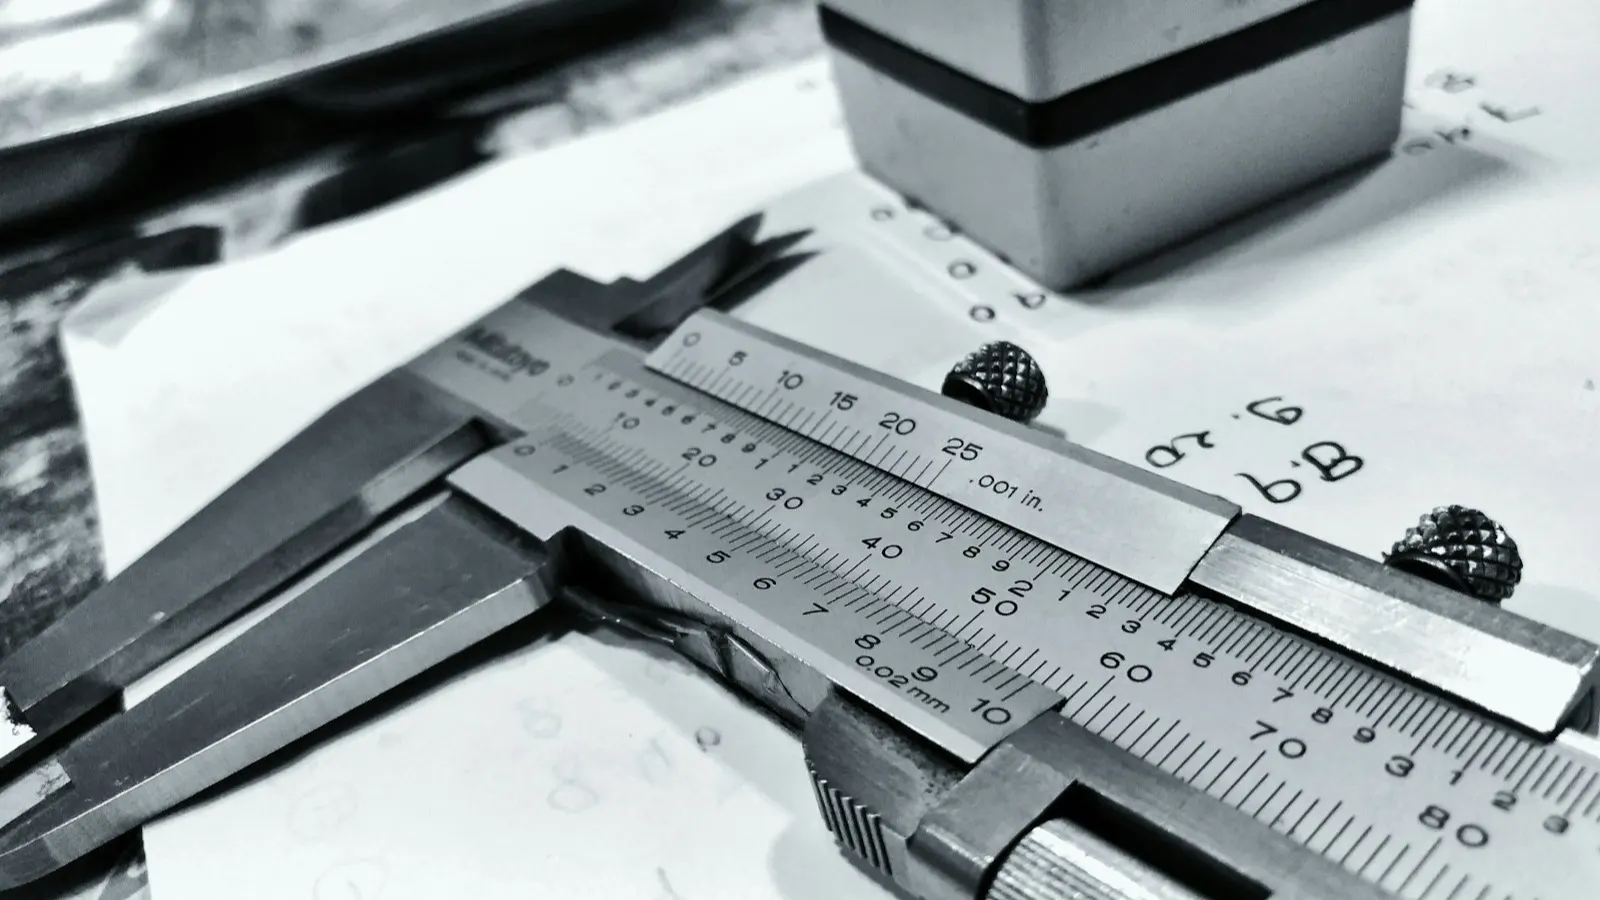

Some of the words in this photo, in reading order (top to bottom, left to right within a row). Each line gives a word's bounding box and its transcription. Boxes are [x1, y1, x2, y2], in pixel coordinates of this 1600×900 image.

[683, 332, 701, 347] 0
[728, 351, 747, 366] 5
[777, 369, 804, 390] 10
[830, 390, 858, 411] 15
[879, 412, 916, 436] 20
[942, 437, 983, 461] 25
[969, 474, 1019, 498] .001
[1021, 489, 1044, 512] in.
[514, 445, 536, 456] 0
[552, 465, 569, 475] 1
[584, 484, 606, 496] 2
[623, 505, 645, 517] 3
[664, 528, 686, 540] 4
[706, 550, 731, 564] 5
[753, 577, 777, 591] 6
[802, 602, 829, 617] 7
[854, 634, 881, 650] 8
[911, 666, 938, 683] 9
[971, 699, 1012, 725] 10
[613, 411, 640, 430] 10
[681, 447, 717, 467] 20
[766, 488, 804, 510] 30
[862, 537, 903, 559] 40
[971, 587, 1018, 616] 50
[1100, 652, 1152, 683] 60
[1249, 720, 1307, 759] 70
[1418, 805, 1490, 848] 80
[702, 423, 717, 433] 7
[720, 433, 736, 443] 8
[741, 443, 757, 453] 9
[754, 458, 769, 470] 1
[787, 463, 799, 473] 1
[806, 473, 823, 485] 2
[831, 485, 847, 496] 3
[856, 498, 872, 508] 4
[880, 507, 898, 519] 5
[907, 520, 924, 532] 6
[936, 533, 953, 543] 7
[963, 546, 981, 558] 8
[992, 560, 1010, 572] 9
[1008, 580, 1033, 598] 2
[1058, 589, 1070, 601] 1
[1086, 604, 1107, 619] 2
[1121, 621, 1141, 634] 3
[1158, 639, 1177, 651] 4
[1193, 653, 1215, 668] 5
[1231, 671, 1252, 686] 6
[1272, 688, 1294, 702] 7
[1311, 708, 1334, 724] 8
[1353, 727, 1375, 743] 9
[1385, 755, 1415, 778] 3
[1448, 771, 1463, 785] 1
[1491, 791, 1517, 811] 2
